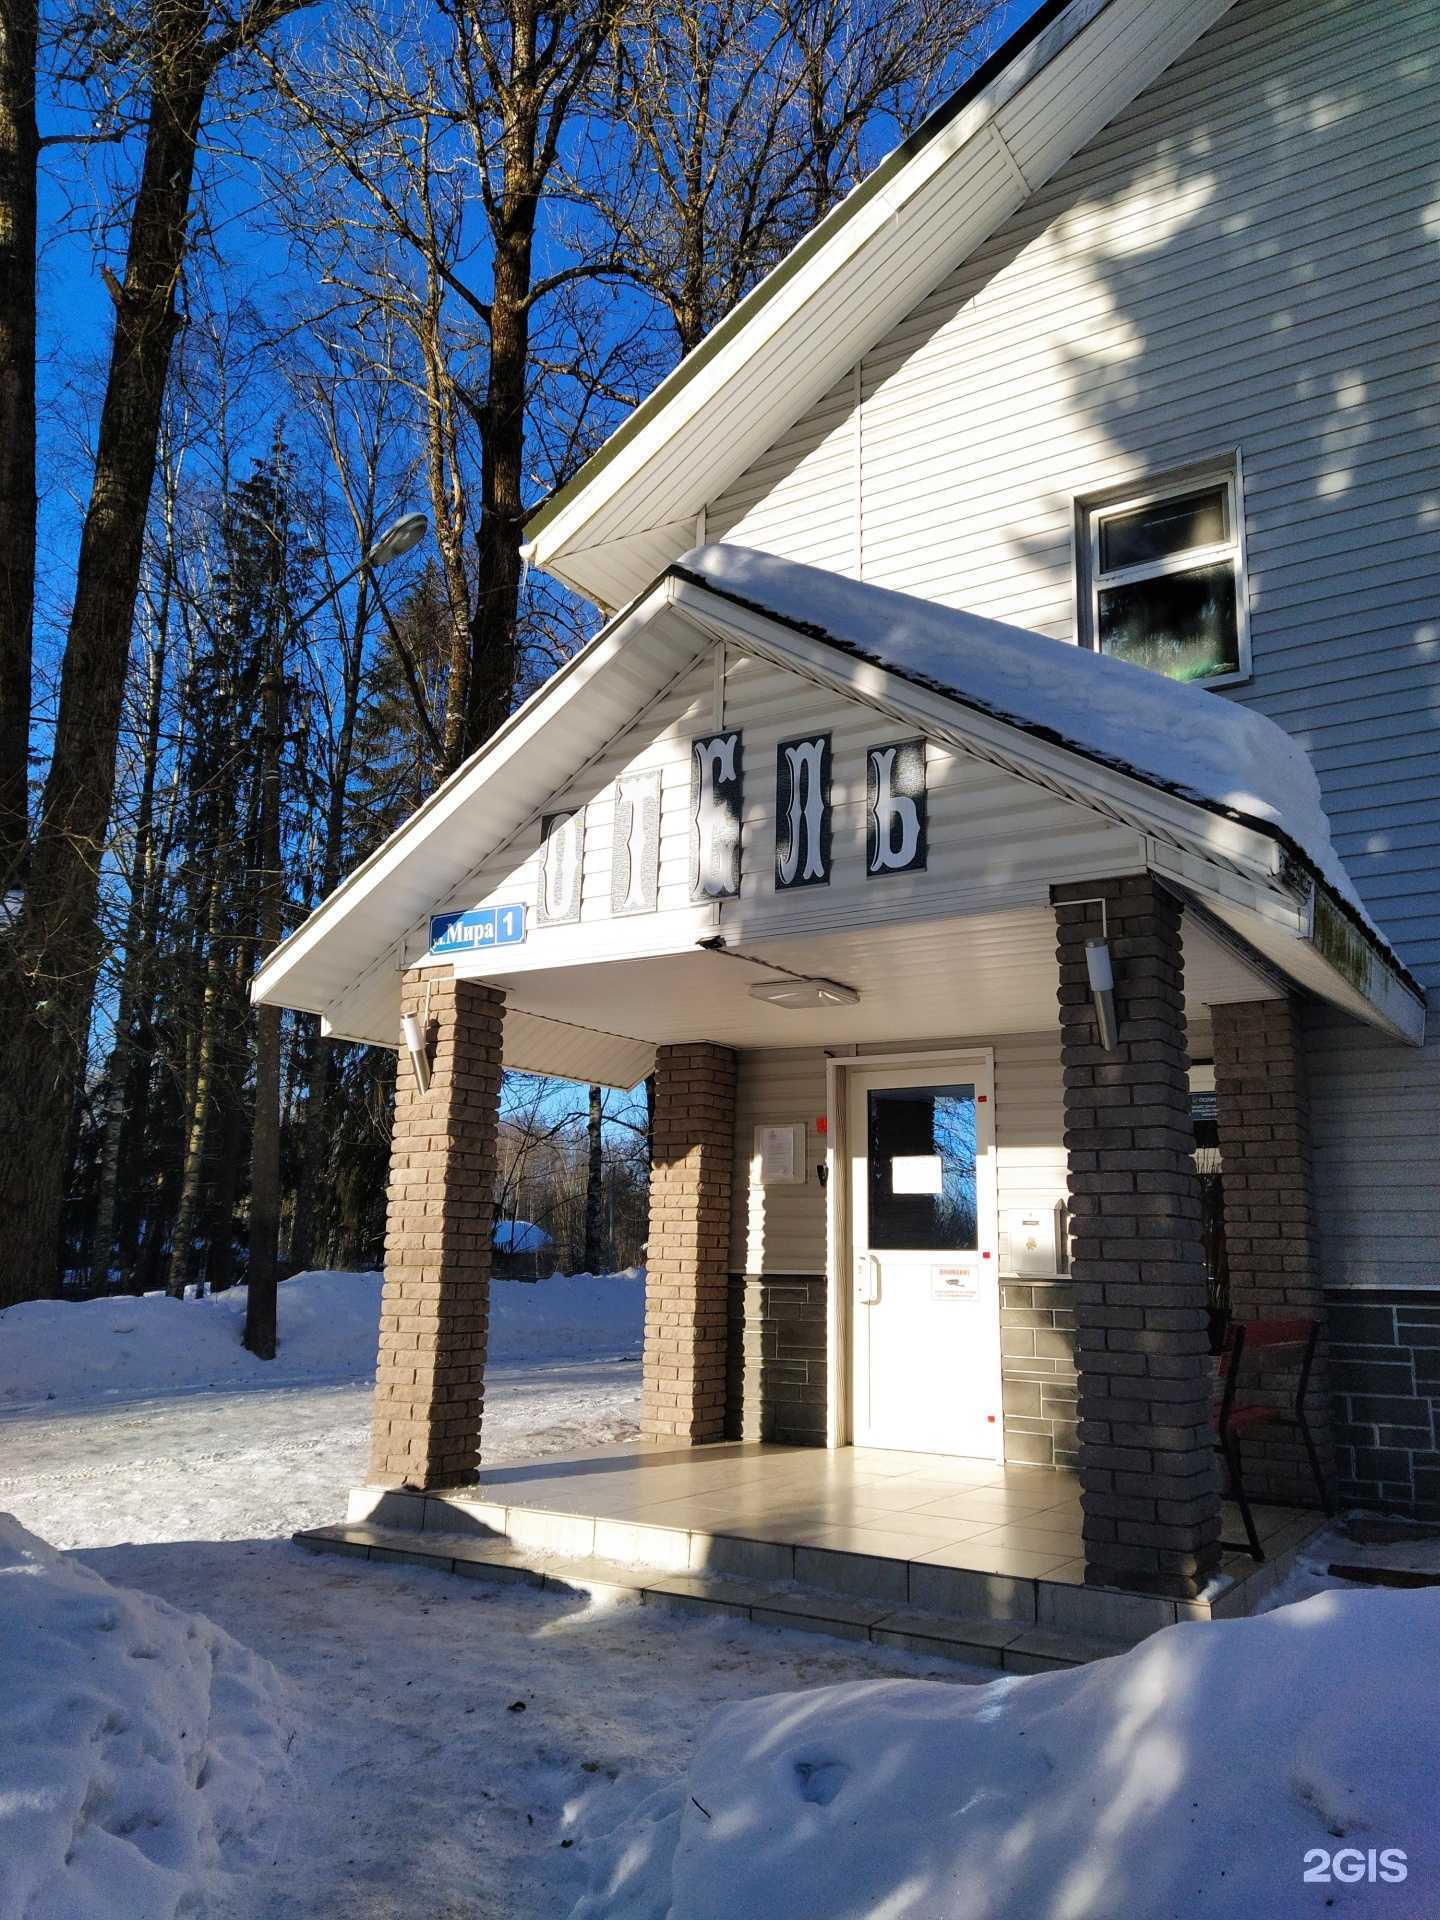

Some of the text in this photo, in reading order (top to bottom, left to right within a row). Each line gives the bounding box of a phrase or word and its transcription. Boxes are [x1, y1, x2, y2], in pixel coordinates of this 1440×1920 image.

[542, 734, 920, 918] ОТЕЛЬ
[447, 921, 494, 946] Мира
[502, 911, 514, 936] 1
